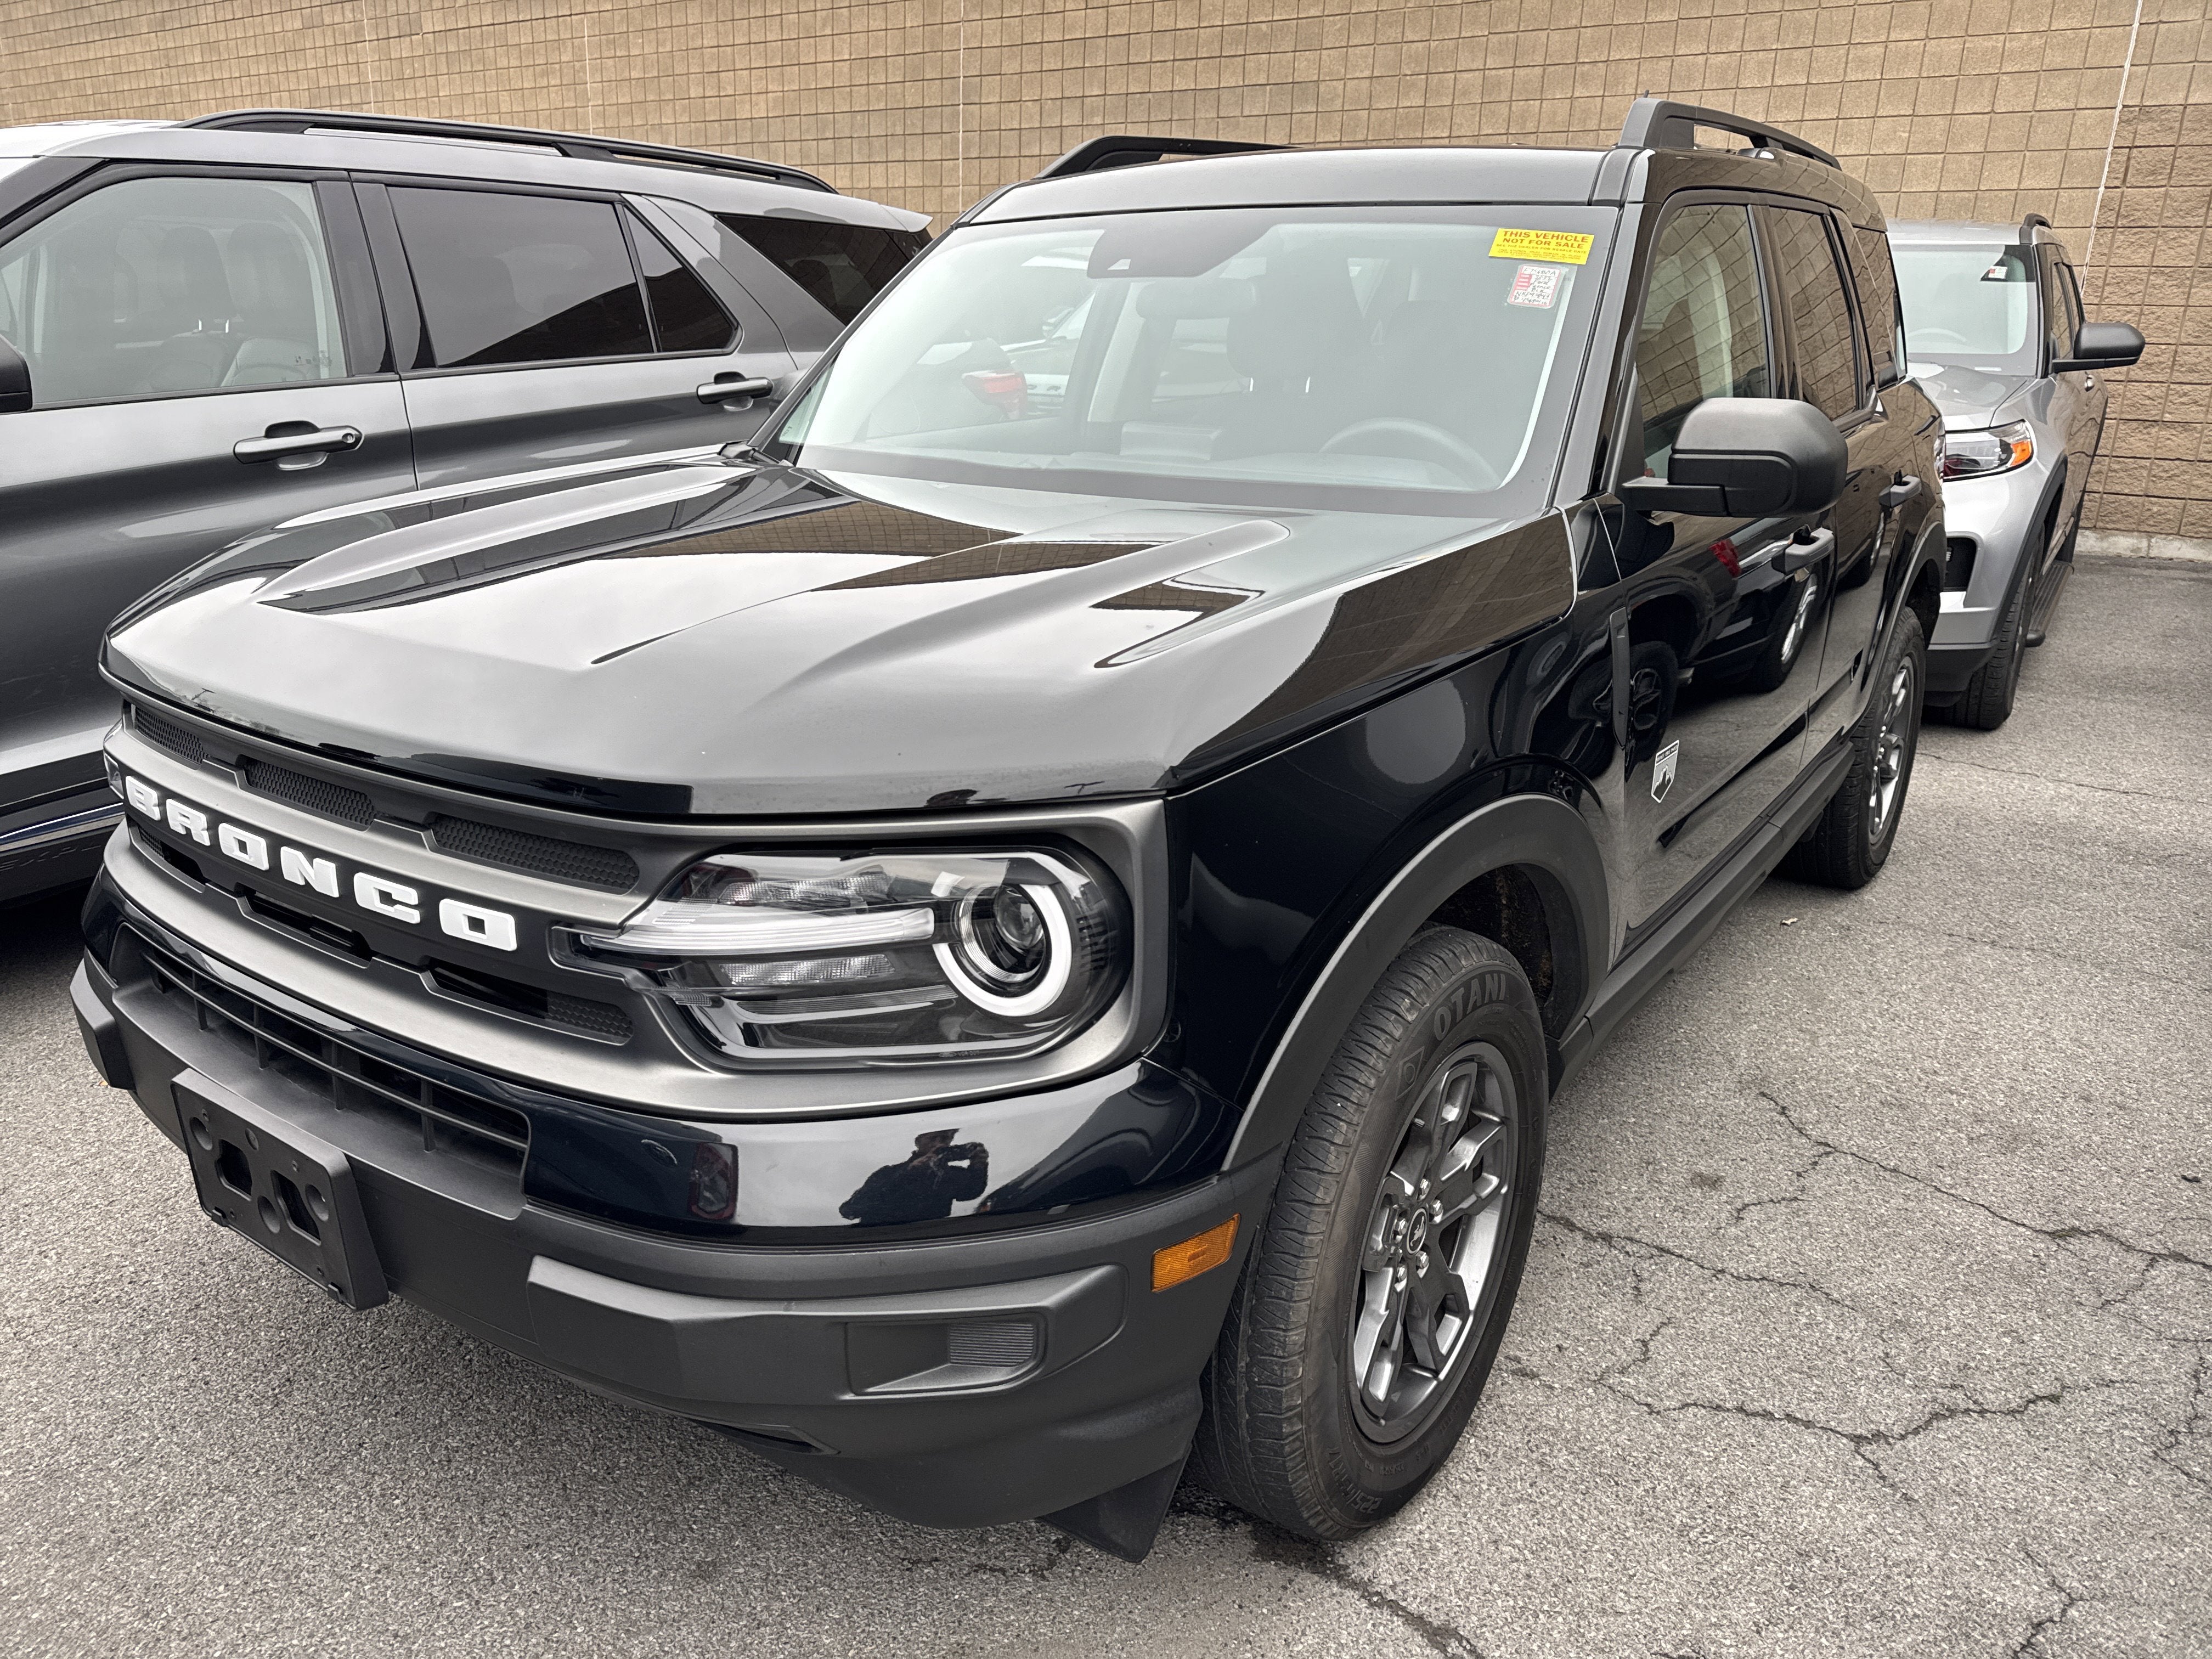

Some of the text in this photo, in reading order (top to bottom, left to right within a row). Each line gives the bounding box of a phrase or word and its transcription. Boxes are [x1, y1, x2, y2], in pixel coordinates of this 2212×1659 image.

[1535, 232, 1590, 243] VEHICLE
[125, 775, 517, 952] BRONCO
[1434, 973, 1506, 1041] OTANI
